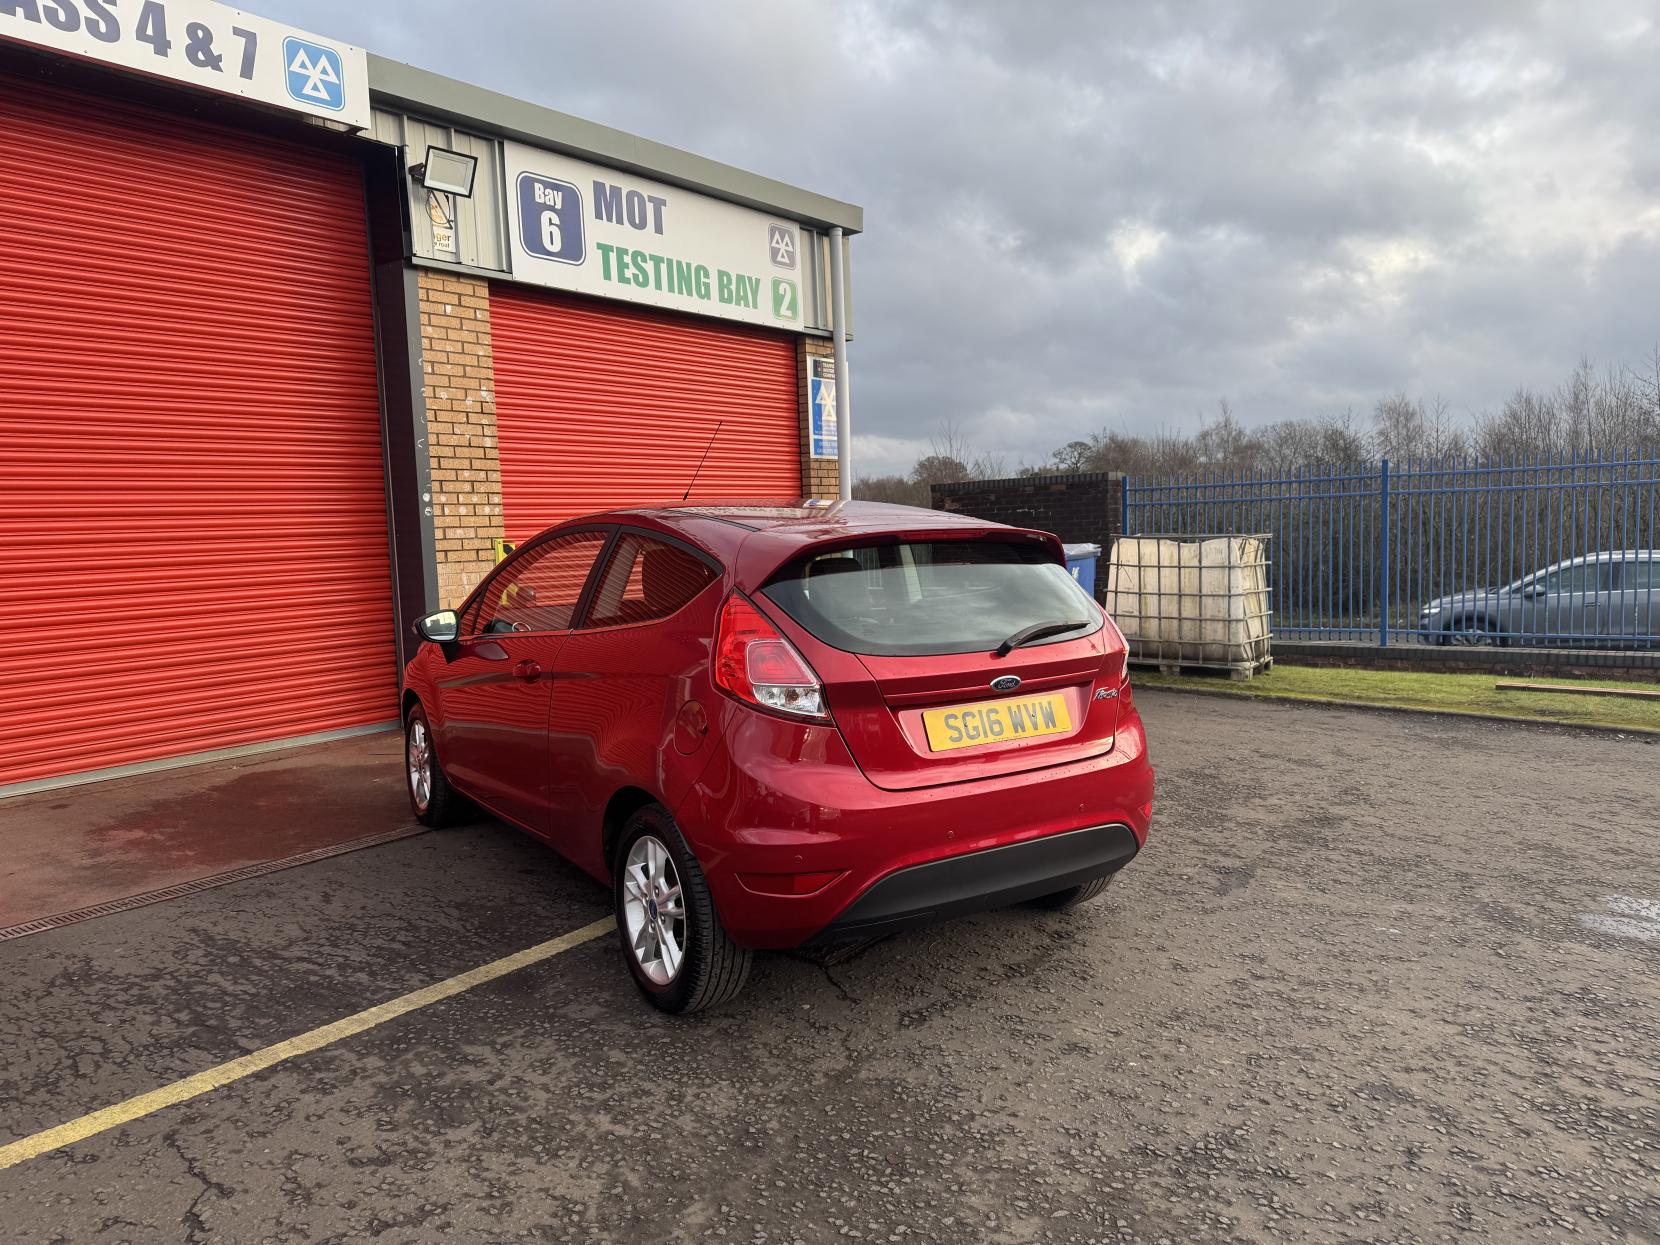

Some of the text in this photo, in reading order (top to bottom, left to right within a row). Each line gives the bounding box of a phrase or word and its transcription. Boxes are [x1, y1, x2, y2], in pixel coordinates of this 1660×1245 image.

[135, 0, 172, 58] 4
[184, 22, 224, 73] &
[231, 25, 258, 81] 7
[534, 182, 563, 210] Bay
[592, 180, 667, 236] MOT
[540, 210, 562, 253] 6
[596, 242, 761, 310] TESTING BAY
[778, 282, 793, 317] 2
[943, 700, 1057, 743] SG16 WVW
